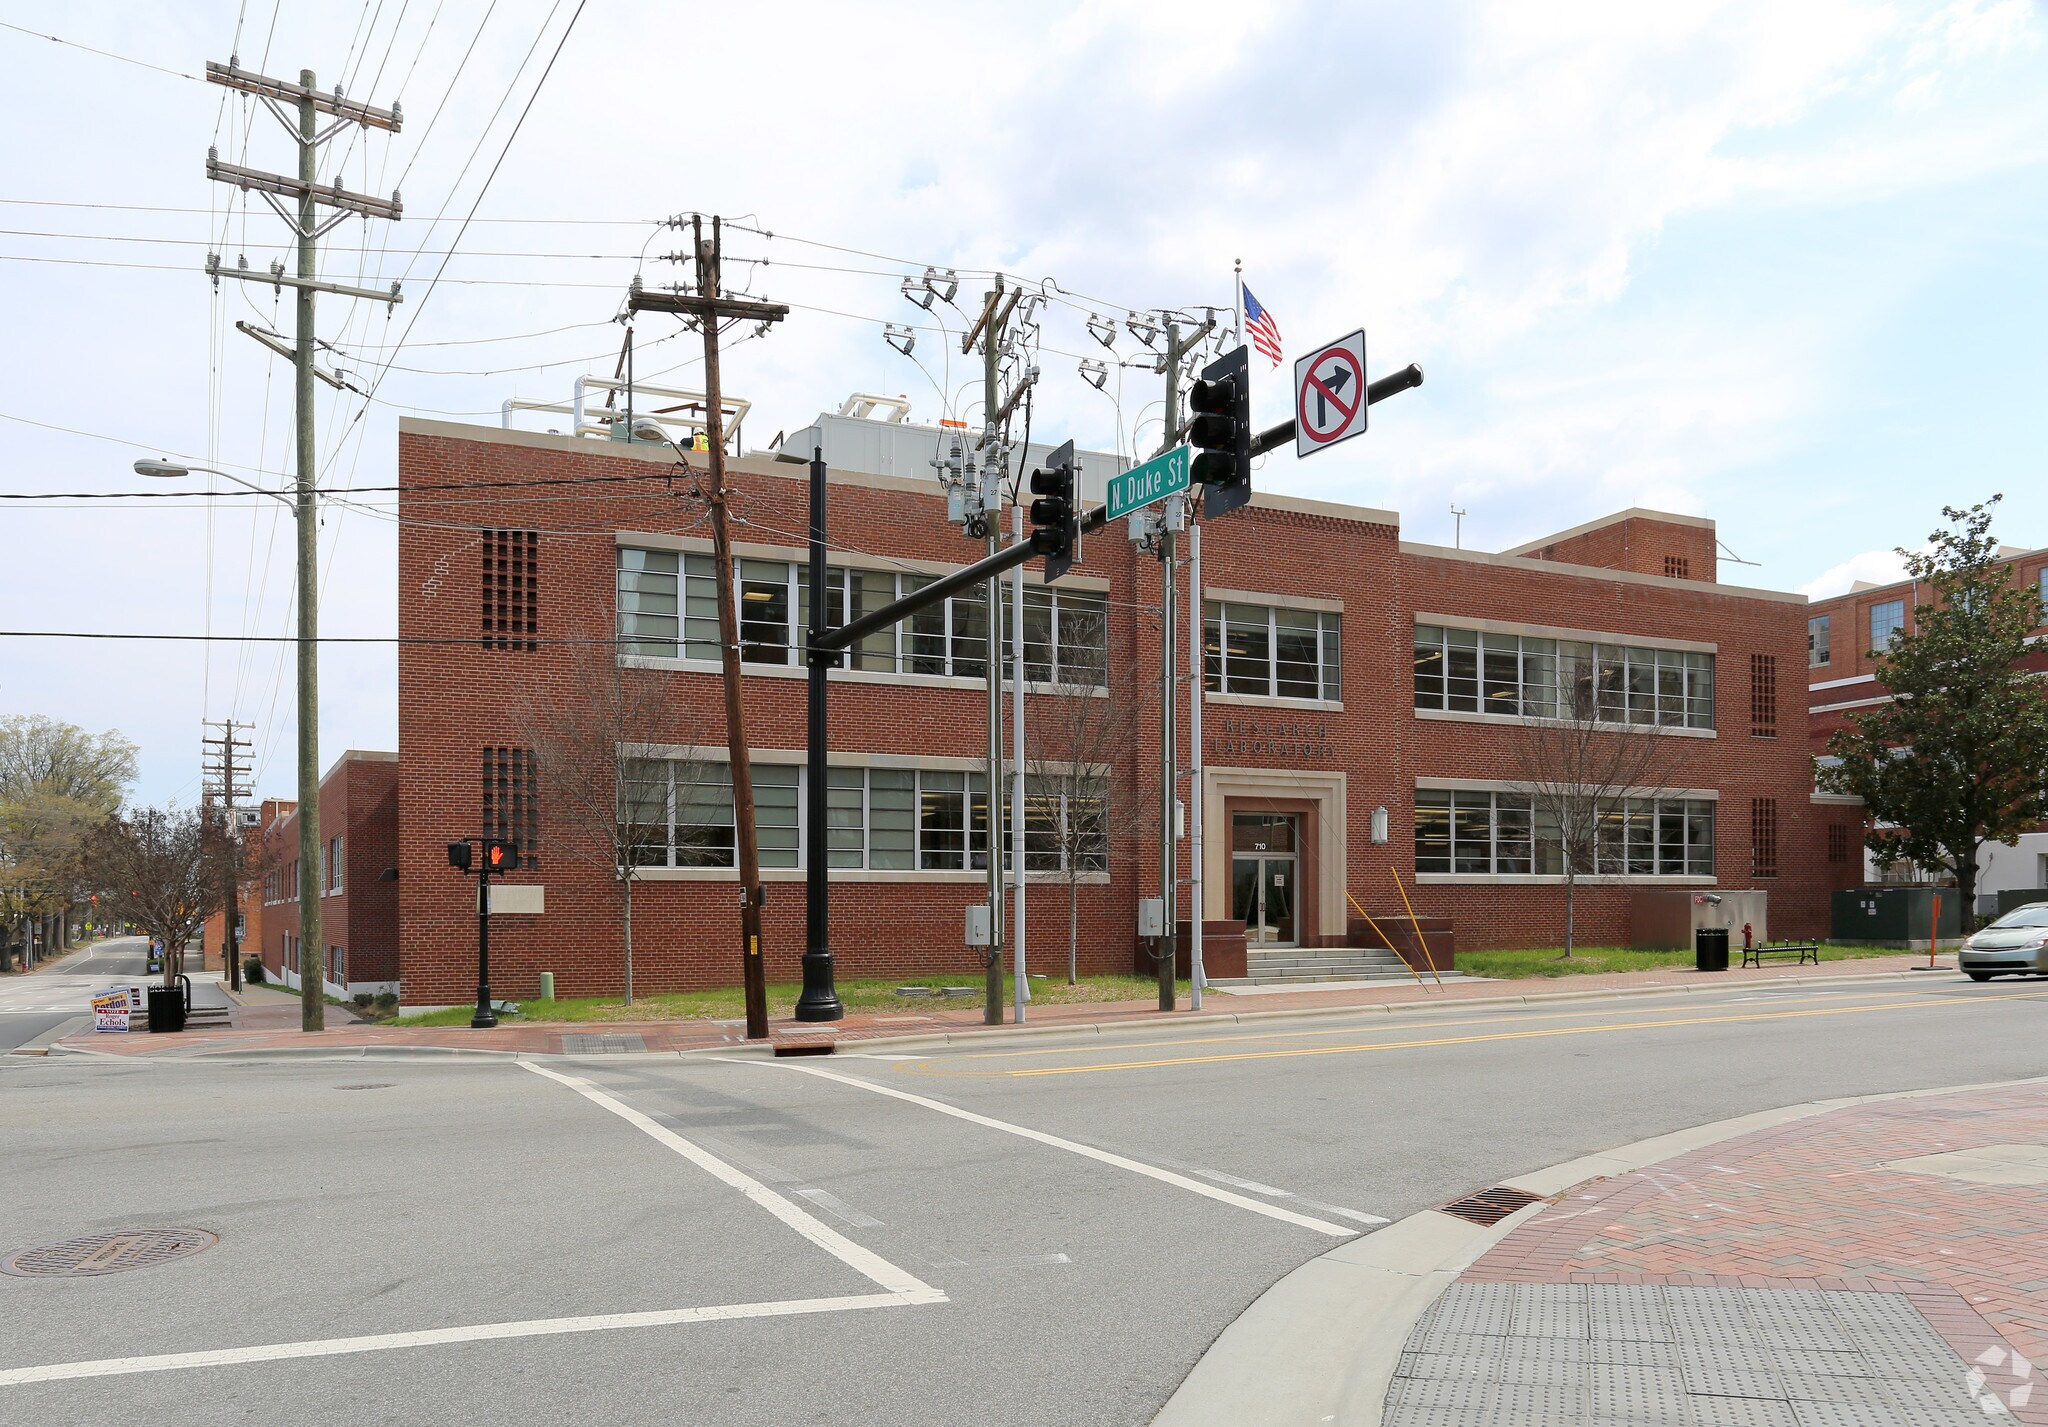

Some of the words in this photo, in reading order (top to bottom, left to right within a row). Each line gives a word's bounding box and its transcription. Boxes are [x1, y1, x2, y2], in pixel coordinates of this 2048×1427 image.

[1112, 483, 1123, 511] N.
[1128, 470, 1161, 504] Duke
[1168, 455, 1183, 486] St
[1226, 720, 1326, 738] RESEARCH
[1214, 738, 1336, 757] LABORATORY
[1254, 842, 1266, 850] 710
